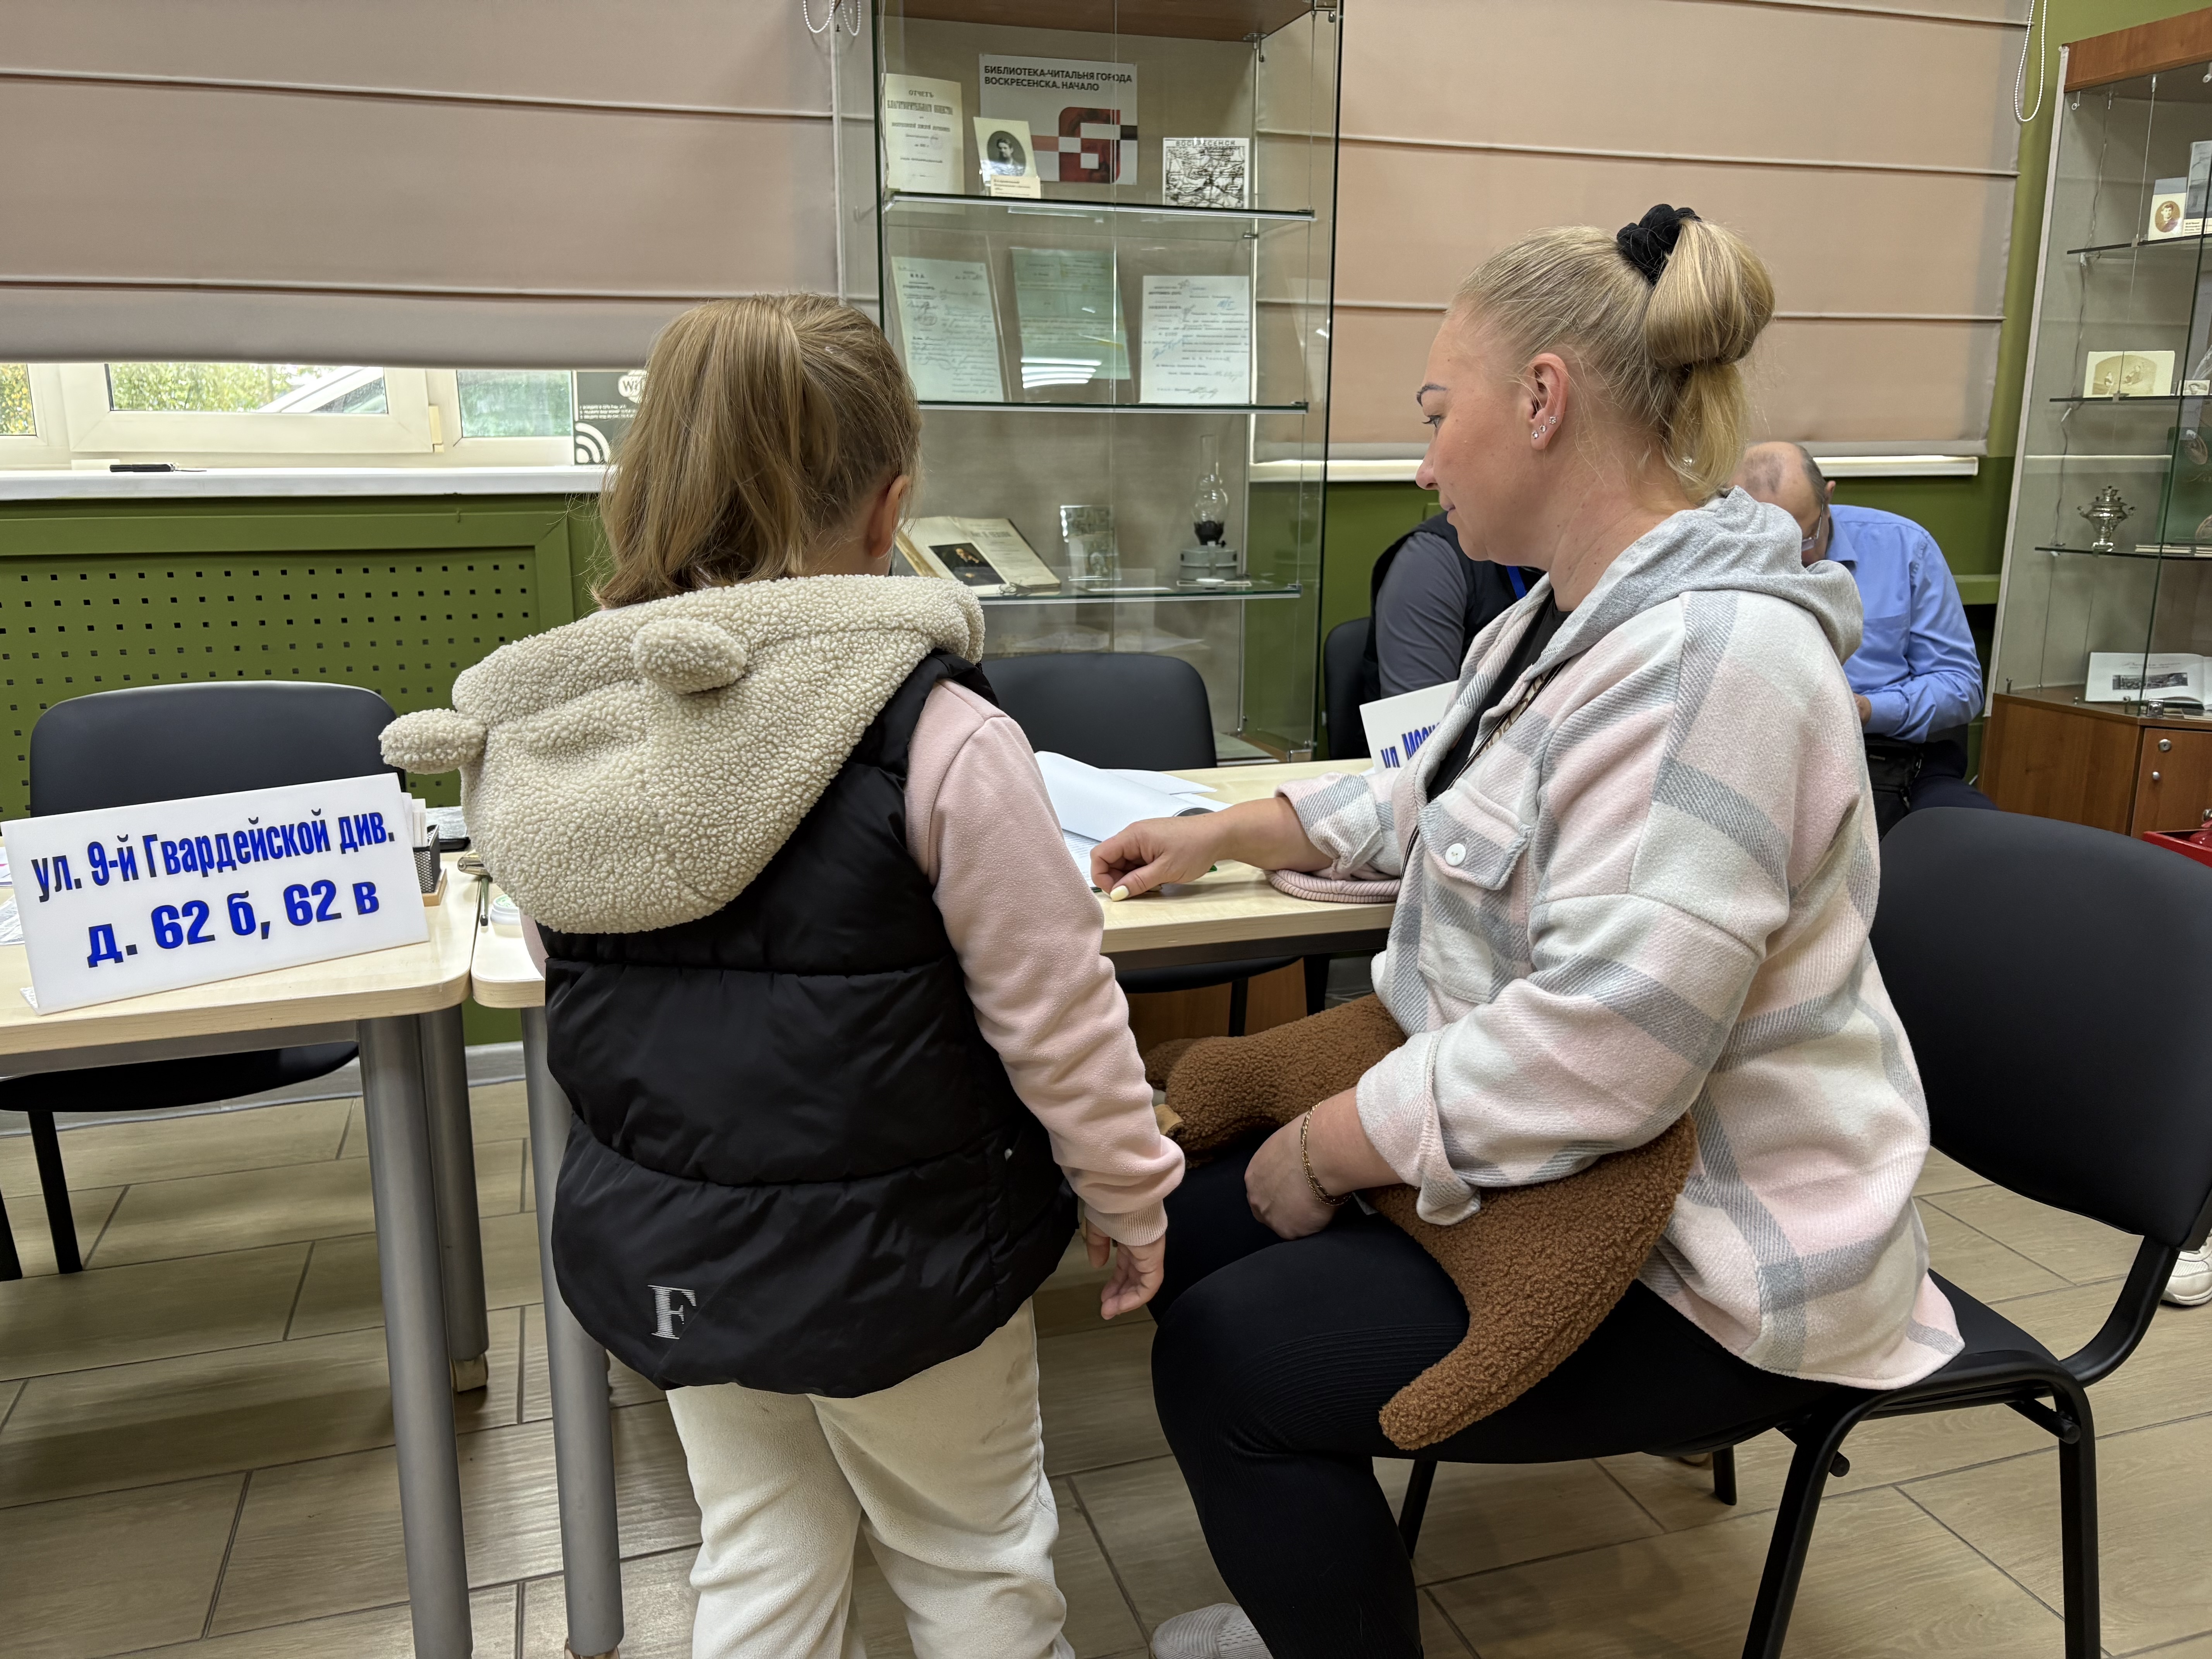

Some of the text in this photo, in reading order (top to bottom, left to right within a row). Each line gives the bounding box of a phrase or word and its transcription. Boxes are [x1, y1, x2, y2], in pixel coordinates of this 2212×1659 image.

[984, 65, 1132, 84] БИБЛИОТЕКА-ЧИТАЛЬНЯ ГОРОДА
[984, 77, 1099, 91] ВОСКРЕСЕНСКА. НАЧАЛО
[31, 855, 82, 903] ул.
[88, 834, 139, 886] 9-й
[142, 808, 331, 878] Гвардейской
[338, 812, 395, 854] див.
[87, 879, 379, 968] д. 62 б, 62 в
[647, 1285, 696, 1339] F
